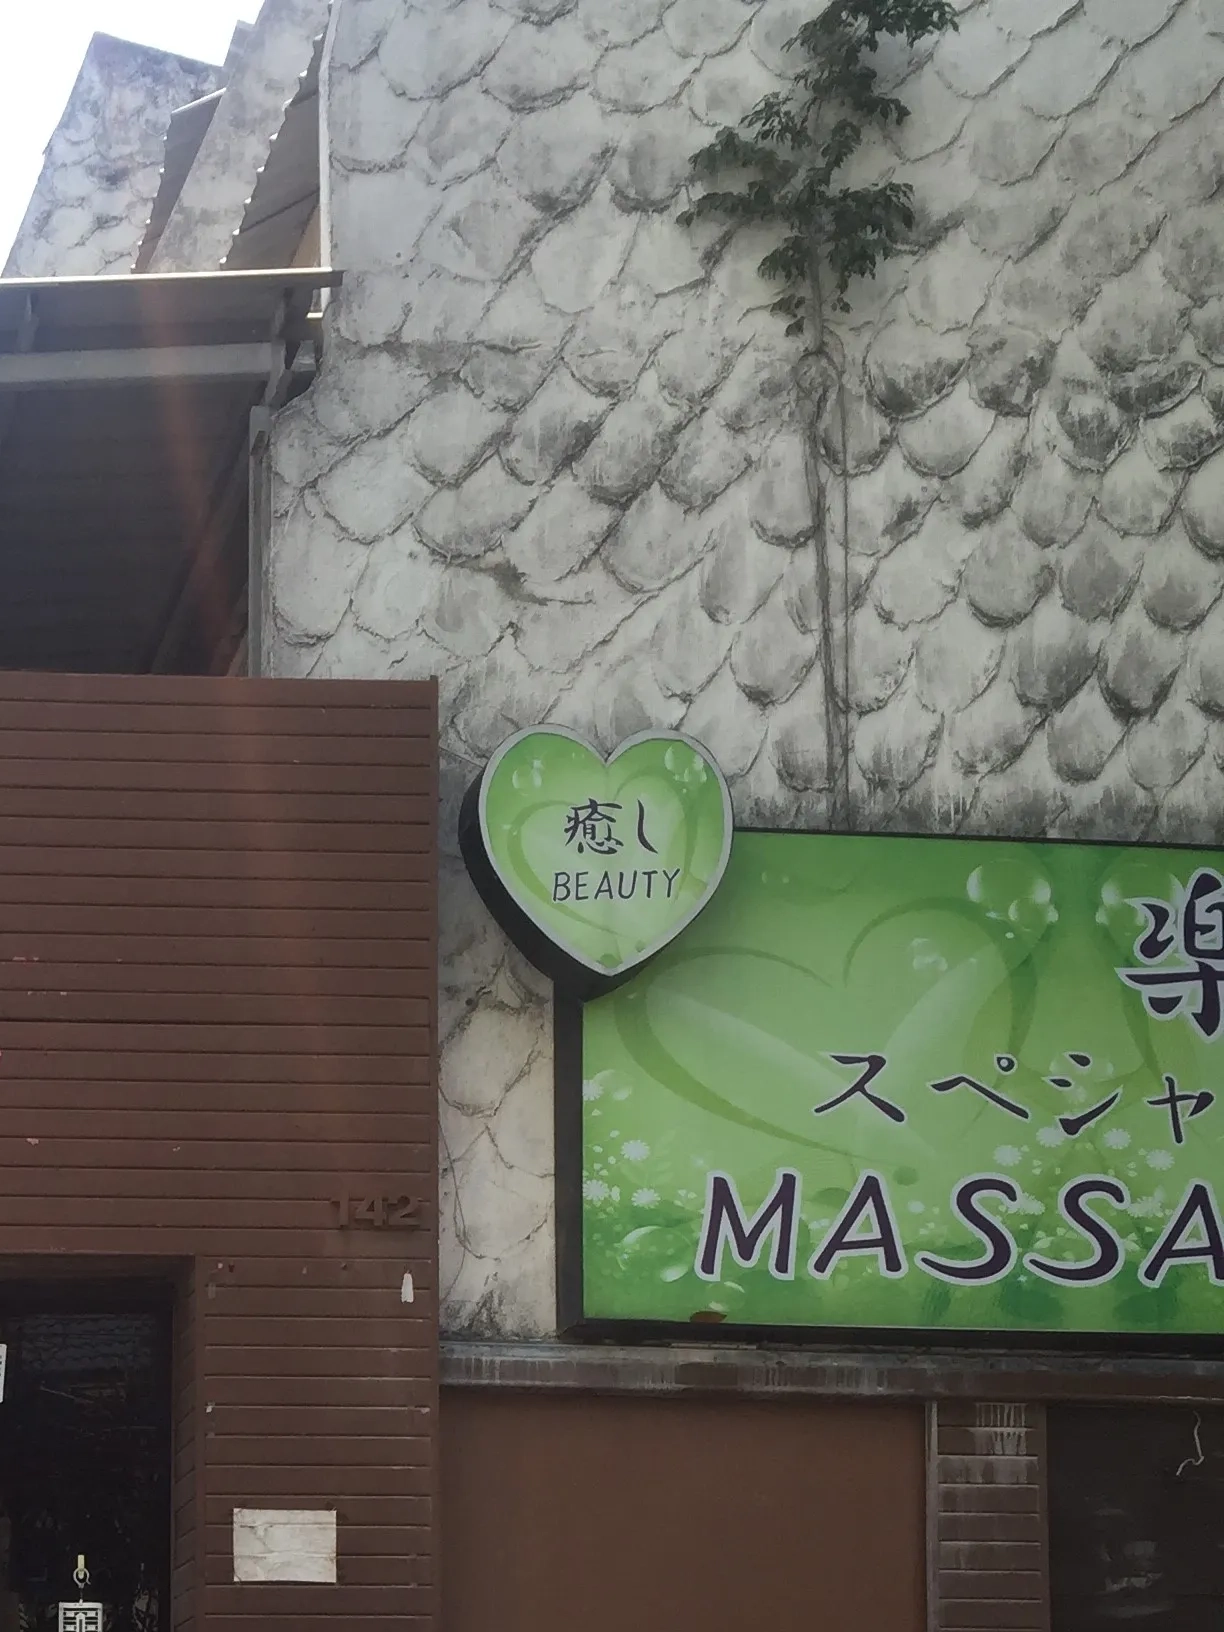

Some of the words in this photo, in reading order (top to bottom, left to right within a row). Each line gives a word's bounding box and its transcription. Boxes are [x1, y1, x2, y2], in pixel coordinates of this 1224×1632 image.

[563, 797, 659, 856] 癒し
[552, 867, 681, 902] BEAUTY
[329, 1192, 422, 1230] 142
[694, 1168, 1224, 1288] MASSA
